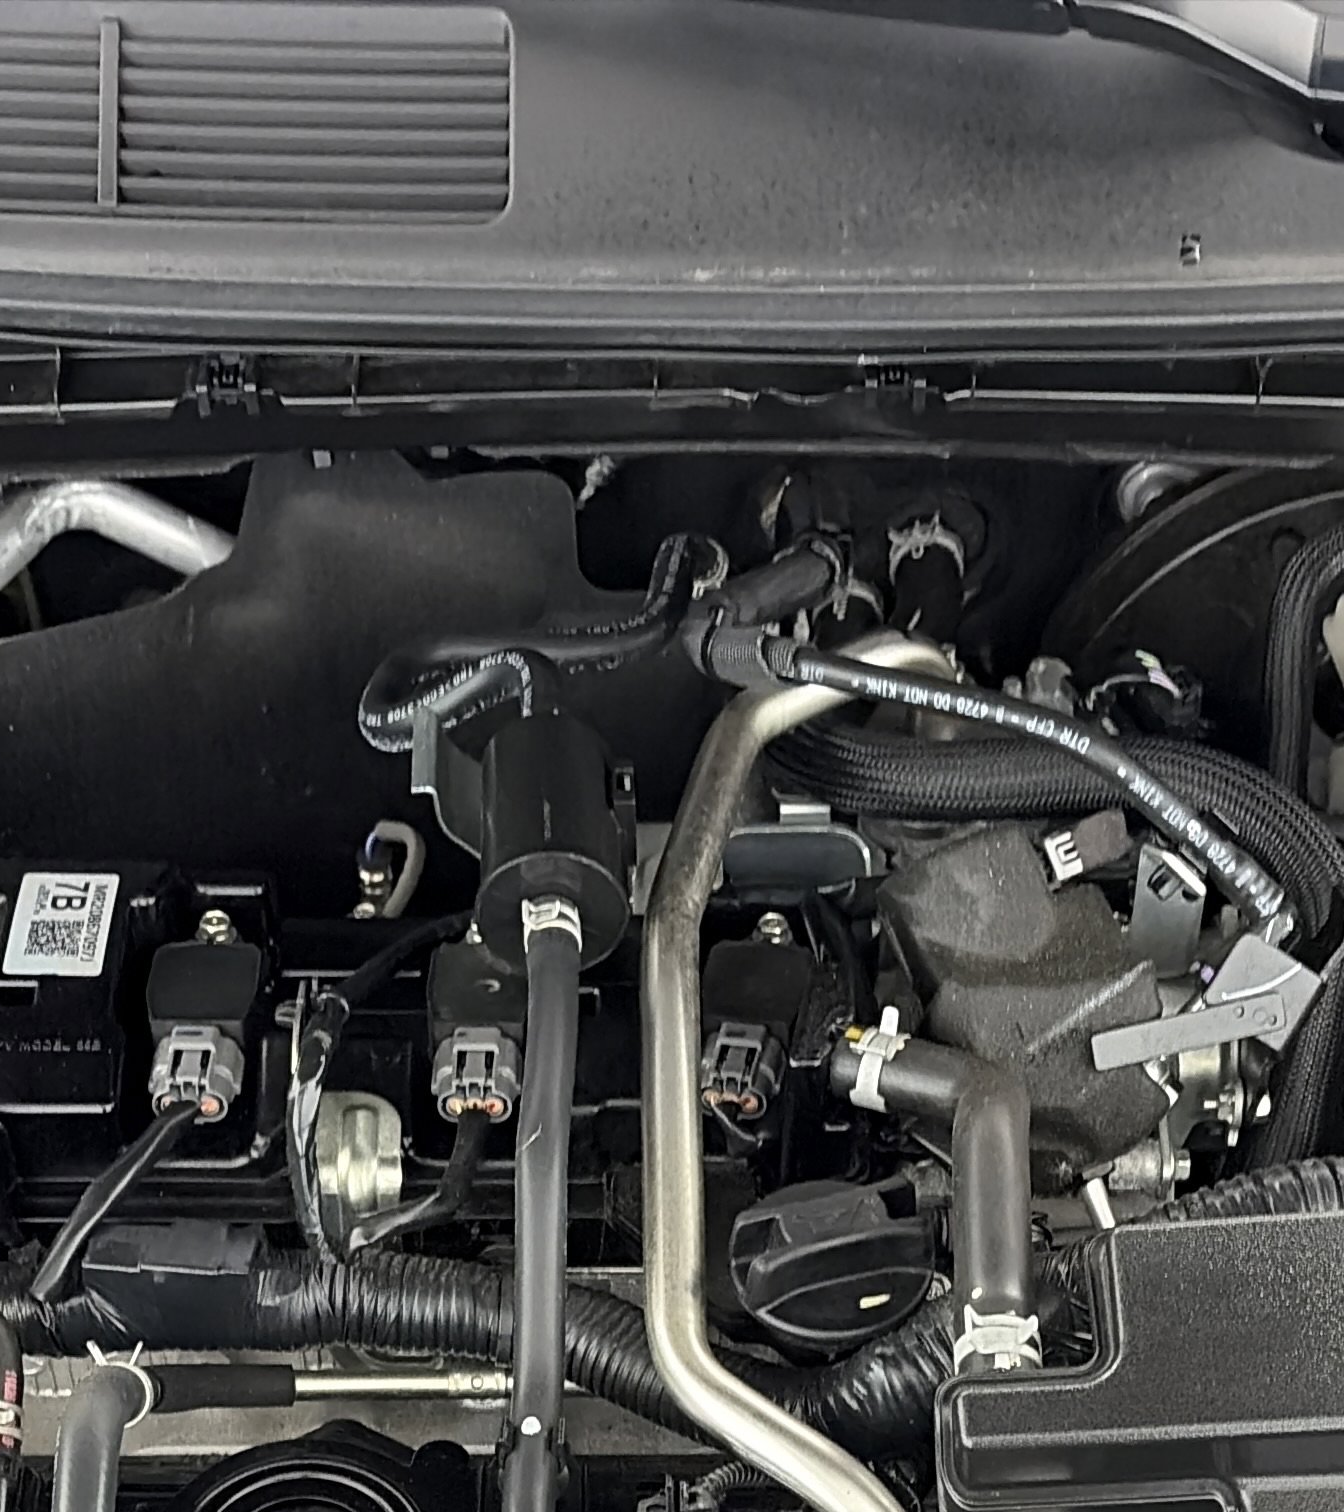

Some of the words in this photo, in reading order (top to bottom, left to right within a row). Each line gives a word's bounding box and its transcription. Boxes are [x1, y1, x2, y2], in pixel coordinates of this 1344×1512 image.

[864, 677, 898, 700] KINK
[903, 684, 929, 705] NOT
[1131, 771, 1162, 805] KINK
[1161, 799, 1189, 830] NOT
[50, 881, 91, 911] 7B
